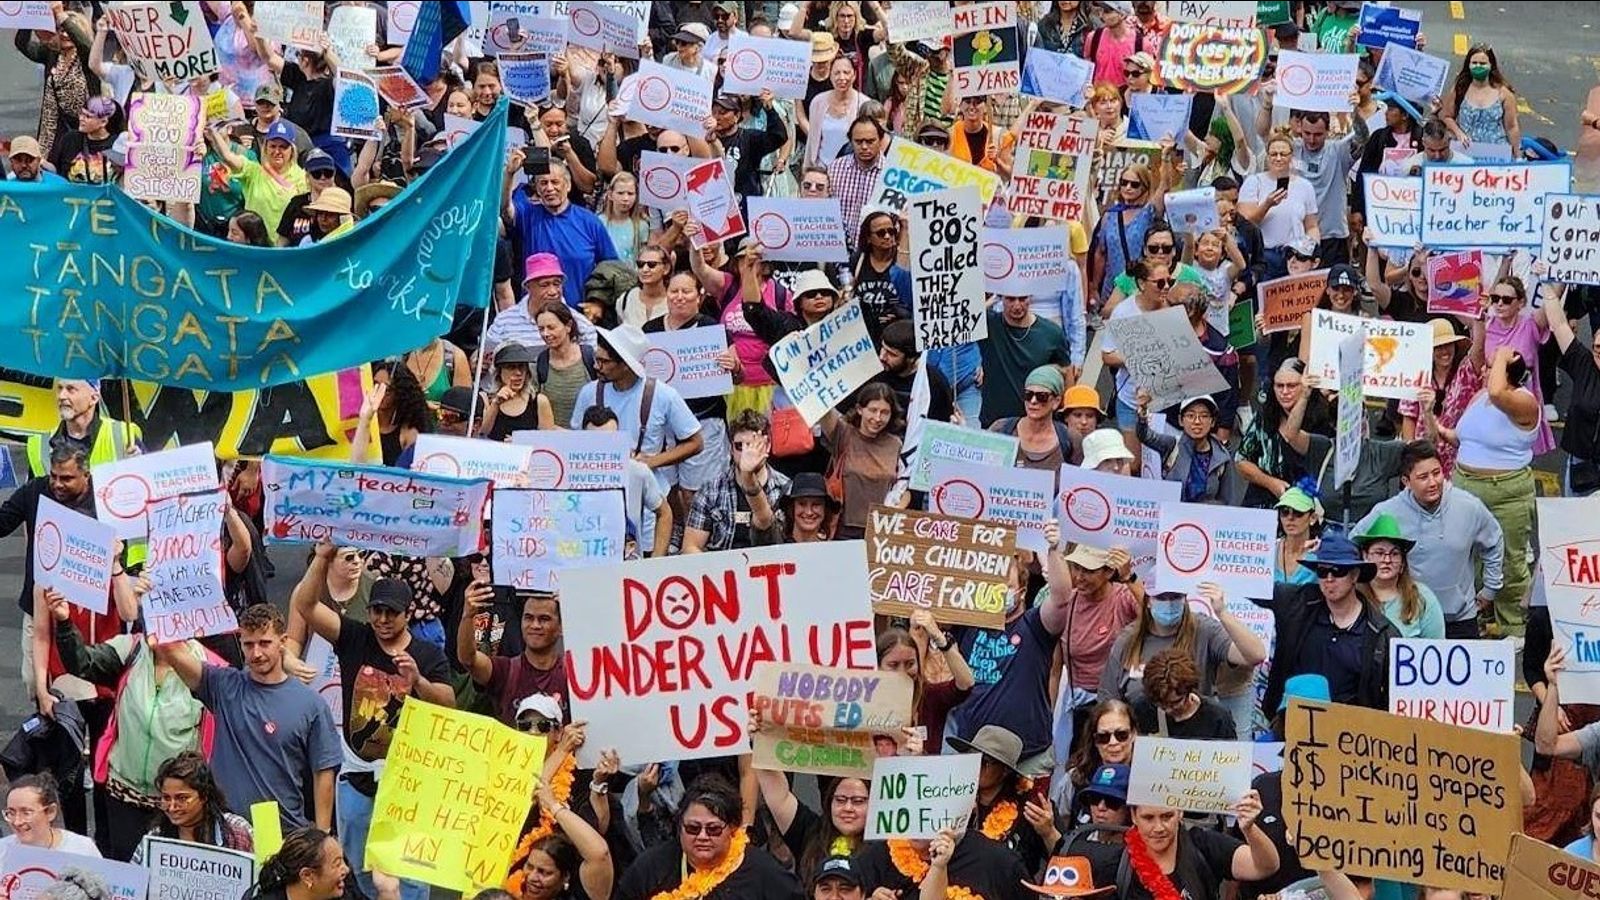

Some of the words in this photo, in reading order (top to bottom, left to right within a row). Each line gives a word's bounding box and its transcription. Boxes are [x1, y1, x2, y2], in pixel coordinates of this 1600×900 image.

[955, 12, 978, 29] ME
[983, 6, 1008, 25] IN
[1181, 2, 1210, 19] PAY
[122, 27, 192, 59] ALUED!
[154, 48, 217, 80] MORE!
[958, 71, 969, 89] 5
[977, 70, 1019, 90] YEARS
[1026, 112, 1057, 130] HOW
[1067, 118, 1084, 134] I
[1020, 132, 1052, 151] FEEL
[1058, 136, 1095, 154] ABOUT
[1013, 176, 1042, 196] THE
[1431, 170, 1464, 193] Hey
[1473, 168, 1530, 191] Chris!
[914, 200, 958, 219] The
[1008, 196, 1048, 216] LATEST
[1052, 202, 1084, 221] OFFER
[1429, 191, 1457, 214] Try
[1472, 190, 1515, 215] being
[1534, 196, 1544, 206] a
[1551, 202, 1589, 220] Our
[63, 197, 119, 236] TE
[793, 215, 822, 223] INVEST
[794, 222, 840, 231] TEACHERS
[1430, 214, 1491, 234] teacher
[1500, 215, 1523, 233] for
[1525, 213, 1536, 234] 1
[794, 232, 823, 240] INVEST
[796, 239, 845, 248] AOTEAROA
[919, 243, 978, 273] Called
[1017, 246, 1049, 255] INVEST
[1017, 251, 1065, 262] TEACHERS
[1547, 246, 1595, 264] your
[1018, 262, 1049, 272] INVEST
[1018, 268, 1066, 279] AOTEAROA
[916, 272, 964, 293] THEY
[920, 290, 958, 307] WANT
[1296, 295, 1316, 307] JUST
[918, 299, 970, 321] THEIR
[919, 312, 982, 338] SALARY
[1318, 313, 1353, 335] Miss
[677, 345, 708, 355] INVEST
[808, 344, 828, 368] MY
[679, 362, 711, 373] INVEST
[1323, 363, 1336, 380] is
[817, 378, 847, 409] FEE
[568, 451, 606, 461] INVEST
[569, 462, 624, 471] TEACHERS
[153, 466, 186, 479] INVEST
[154, 474, 211, 489] TEACHERS
[289, 469, 337, 491] MY
[357, 472, 444, 497] teacher
[568, 474, 606, 484] INVEST
[988, 486, 1033, 500] INVEST
[988, 497, 1048, 510] TEACHERS
[1115, 497, 1157, 509] INVEST
[153, 502, 217, 530] TEACHER
[352, 510, 401, 527] more
[987, 507, 1031, 520] INVEST
[1113, 517, 1153, 530] INVEST
[299, 524, 335, 540] NOT
[346, 528, 375, 542] JUST
[379, 533, 430, 549] MONEY
[872, 510, 908, 535] WE
[914, 517, 961, 542] CARE
[972, 523, 1008, 547] FOR
[1214, 529, 1254, 540] INVEST
[66, 534, 93, 553] INVEST
[1213, 540, 1270, 553] TEACHERS
[65, 545, 107, 567] TEACHERS
[872, 536, 916, 566] YOUR
[925, 545, 1012, 577] CHILDREN
[1213, 553, 1251, 564] INVEST
[61, 559, 88, 577] INVEST
[193, 562, 211, 577] WE
[1212, 563, 1272, 577] AOTEAROA
[60, 568, 107, 591] AOTEAROA
[148, 588, 183, 610] HAVE
[183, 583, 213, 600] THIS
[623, 552, 798, 642] DON'T
[869, 567, 938, 609] CARE
[974, 581, 1010, 614] US
[565, 634, 713, 702] UNDER
[717, 619, 876, 682] VALUE
[1394, 643, 1472, 687] BOO
[1482, 658, 1506, 677] TO
[776, 671, 881, 703] NOBODY
[755, 694, 826, 730] PUTS
[833, 701, 863, 730] ED
[1396, 699, 1509, 728] BURNOUT
[402, 705, 416, 736] I
[429, 713, 496, 754] TEACH
[498, 739, 534, 770] MY
[1297, 703, 1329, 749] I
[1338, 732, 1418, 768] earned
[1427, 747, 1497, 782] more
[395, 740, 466, 775] STUDENTS
[1184, 749, 1202, 764] Not
[399, 766, 423, 793] for
[879, 772, 908, 801] NO
[912, 773, 976, 801] Teachers
[1168, 768, 1220, 784] INCOME
[1289, 746, 1326, 791] $$
[1339, 757, 1420, 802] picking
[1428, 772, 1506, 811] grapes
[1181, 785, 1227, 800] about
[385, 802, 420, 823] and
[875, 807, 912, 835] NO
[1290, 792, 1352, 823] than
[1355, 794, 1379, 824] I
[1385, 802, 1419, 828] will
[1424, 810, 1449, 832] as
[1458, 813, 1478, 838] a
[401, 838, 444, 863] MY
[1295, 819, 1425, 879] beginning
[1431, 837, 1506, 882] teacher
[158, 852, 243, 880] EDUCATION
